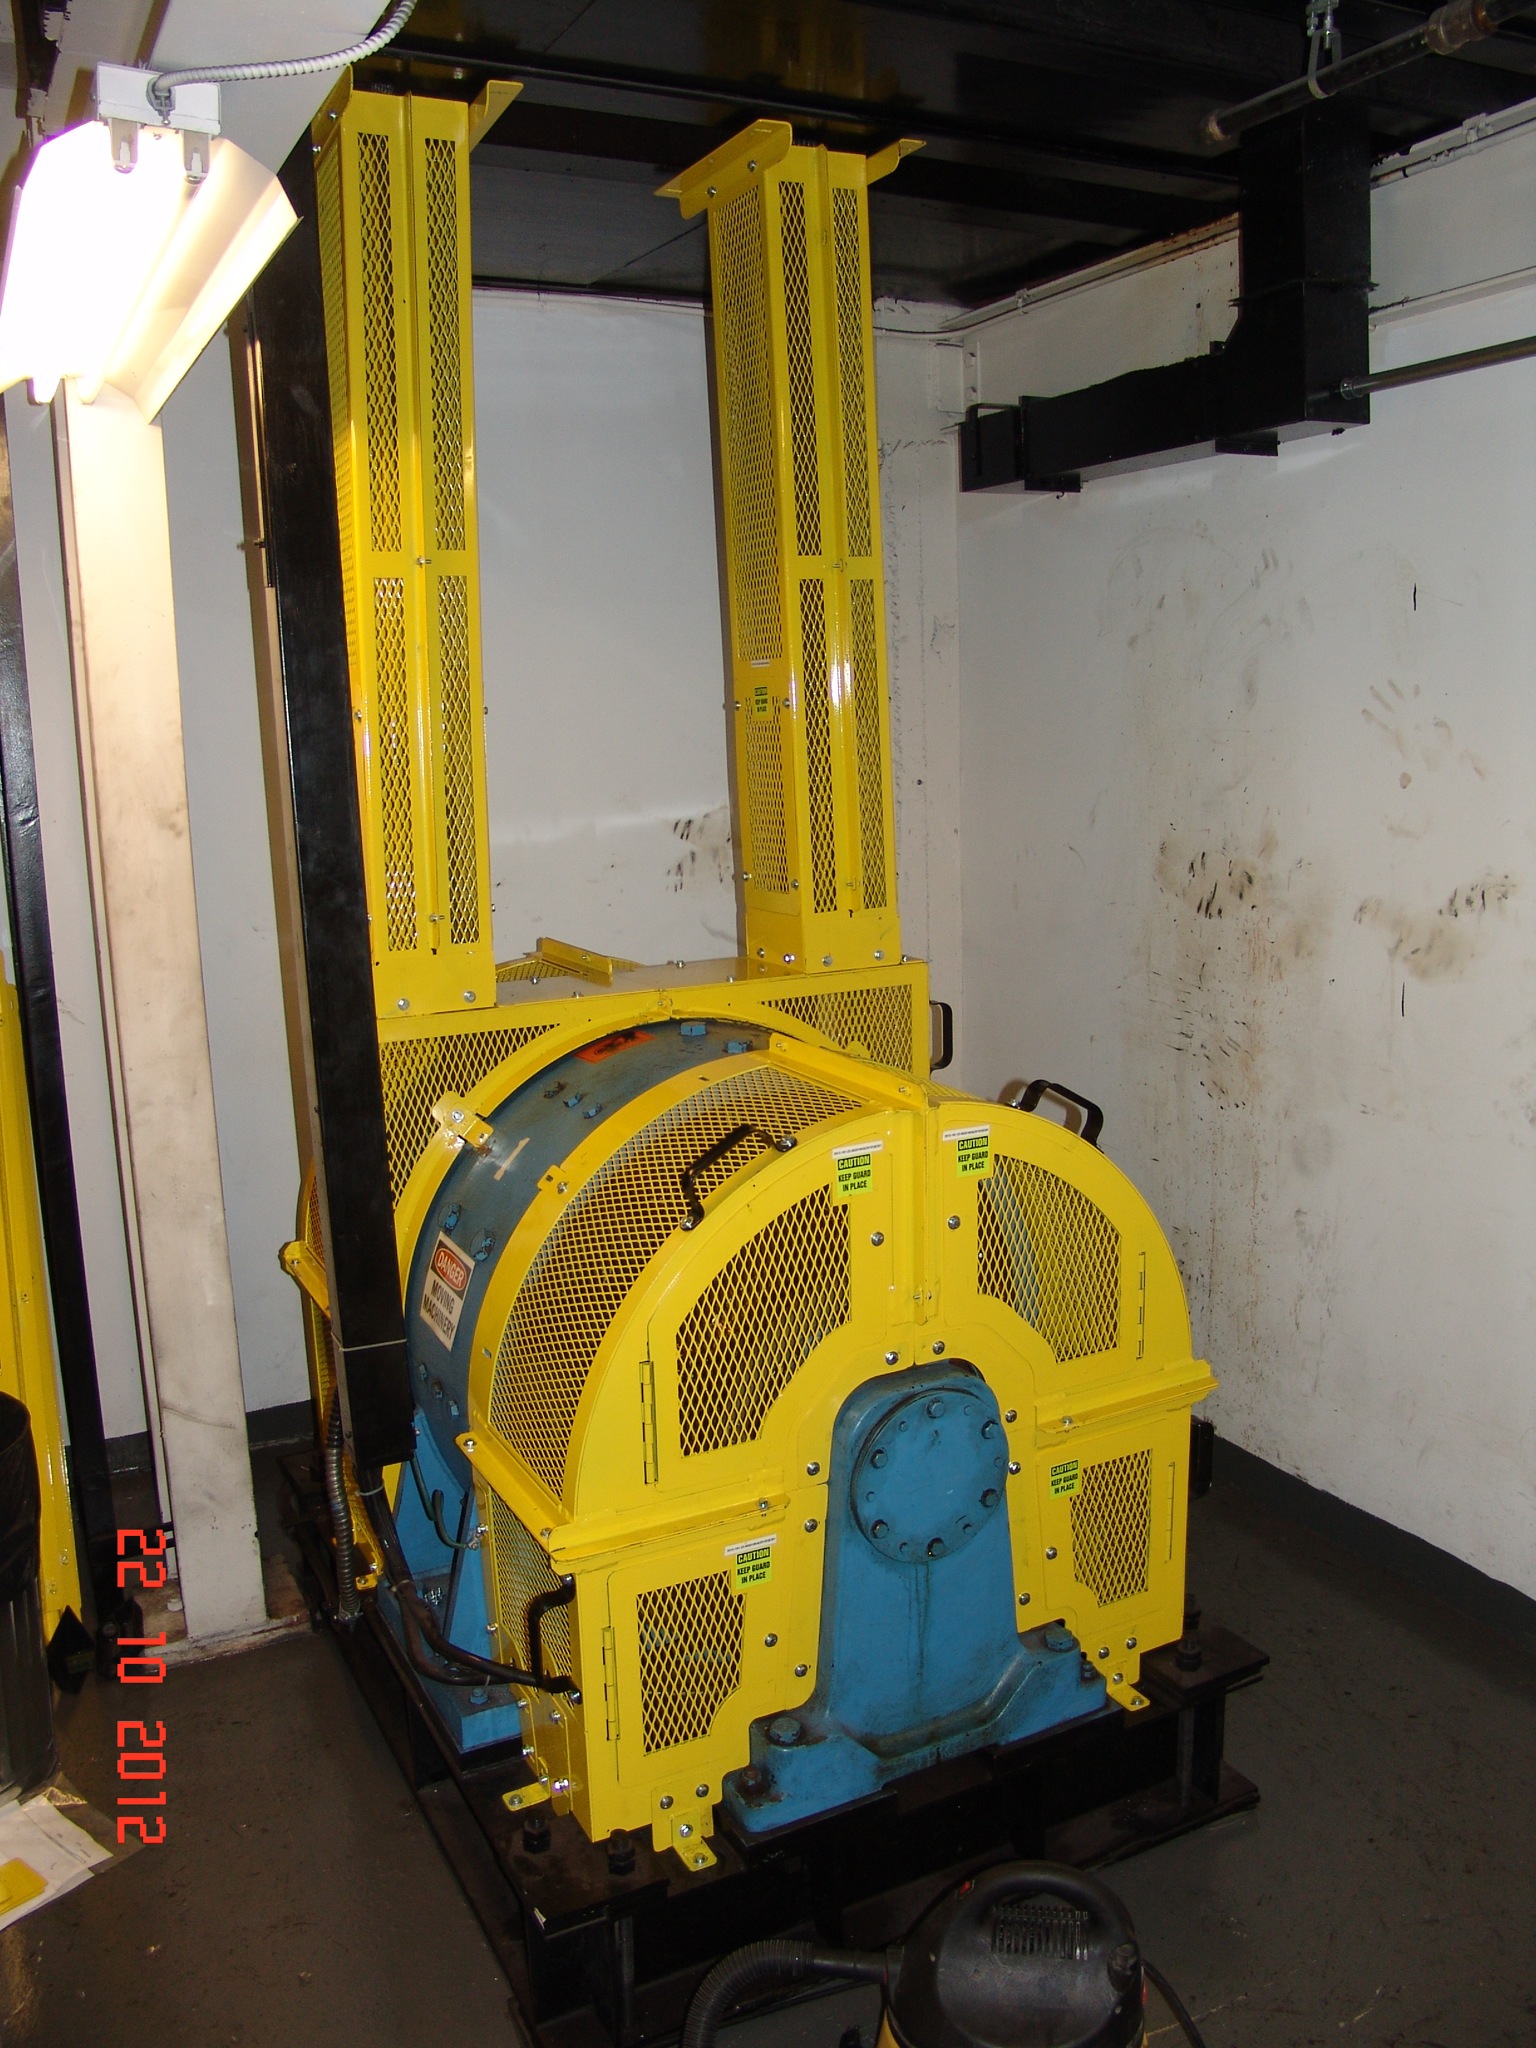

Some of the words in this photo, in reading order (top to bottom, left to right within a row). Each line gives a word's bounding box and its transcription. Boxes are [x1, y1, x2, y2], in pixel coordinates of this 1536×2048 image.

[958, 1137, 988, 1150] CAUTION
[838, 1155, 870, 1169] CAUTION
[958, 1154, 971, 1163] KEEP
[971, 1151, 989, 1161] GUARD
[962, 1164, 968, 1172] IN
[968, 1161, 985, 1171] PLACE
[838, 1173, 852, 1182] KEEP
[853, 1169, 871, 1180] GUARD
[842, 1183, 849, 1192] IN
[850, 1180, 867, 1191] PLACE
[437, 1251, 466, 1286] DANGER
[430, 1279, 455, 1315] MOVING
[422, 1293, 456, 1340] MACHINERY
[1051, 1461, 1077, 1475] CAUTION
[1051, 1478, 1062, 1487] KEEP
[1063, 1473, 1078, 1483] GUARD
[1060, 1482, 1075, 1493] PLACE
[738, 1548, 769, 1564] CAUTION
[737, 1566, 751, 1576] KEEP
[751, 1561, 770, 1572] GUARD
[741, 1576, 748, 1584] IN
[749, 1571, 766, 1582] PLACE
